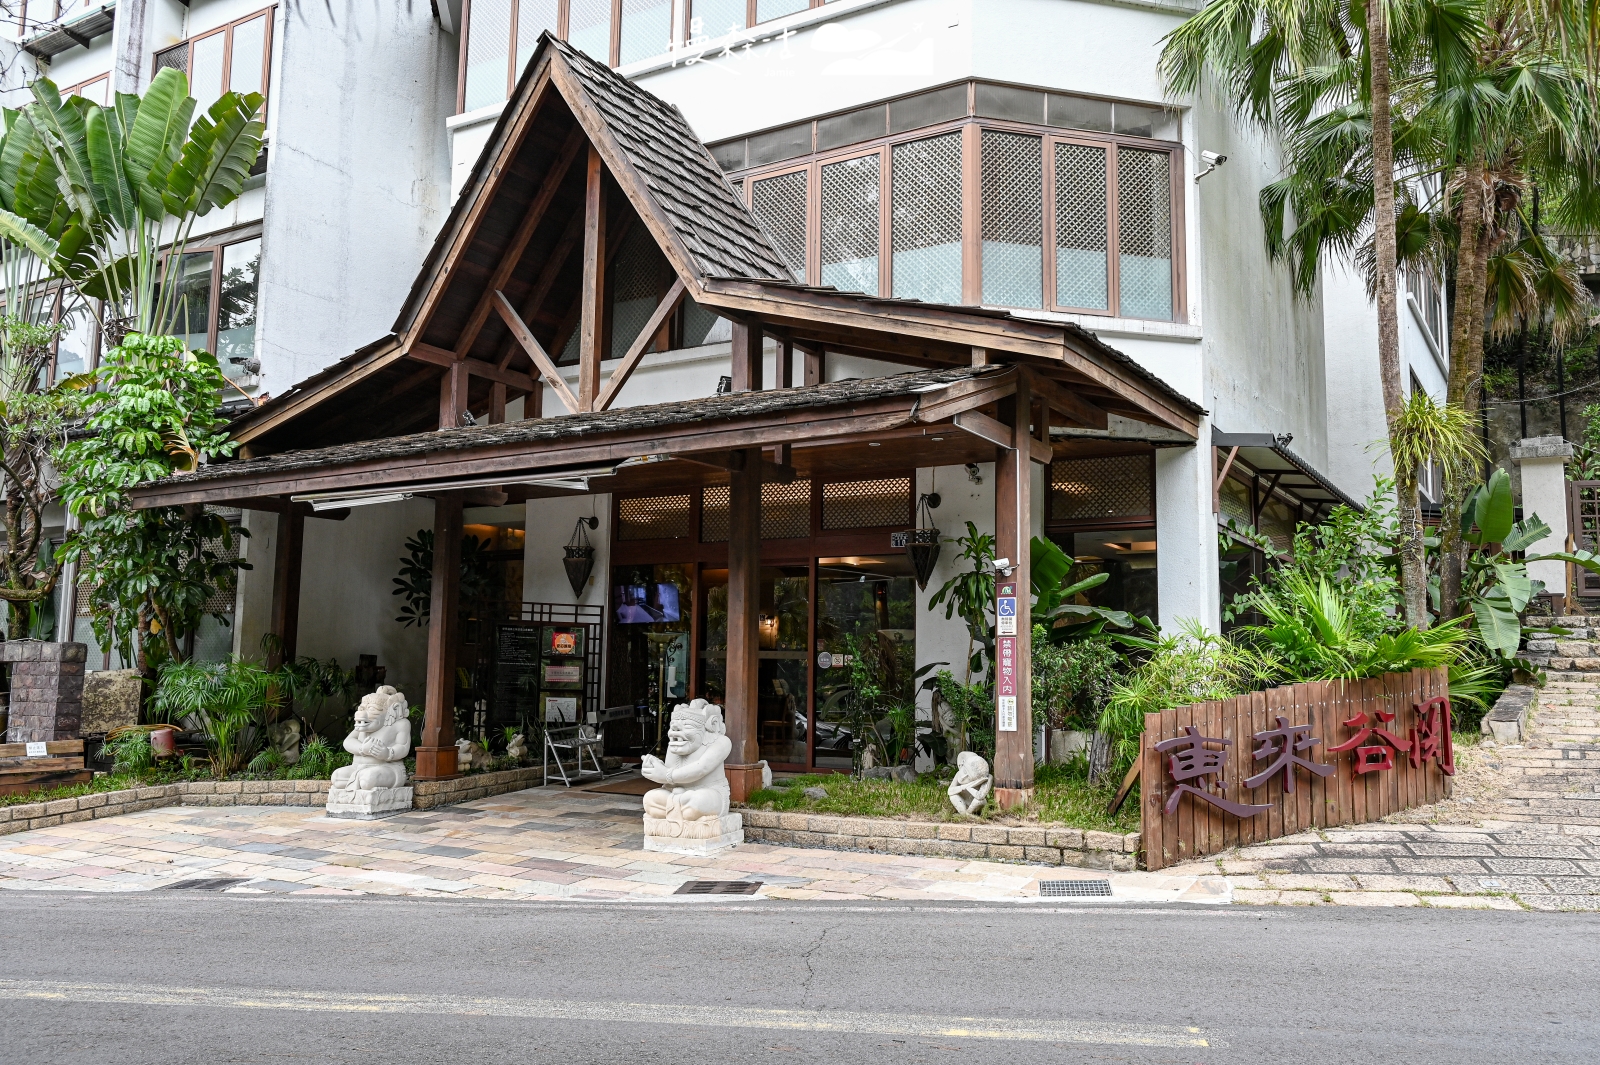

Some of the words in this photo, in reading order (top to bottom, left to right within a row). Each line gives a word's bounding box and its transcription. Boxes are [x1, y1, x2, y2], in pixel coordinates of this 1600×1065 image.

[1002, 639, 1013, 694] 禁帶寵物入內
